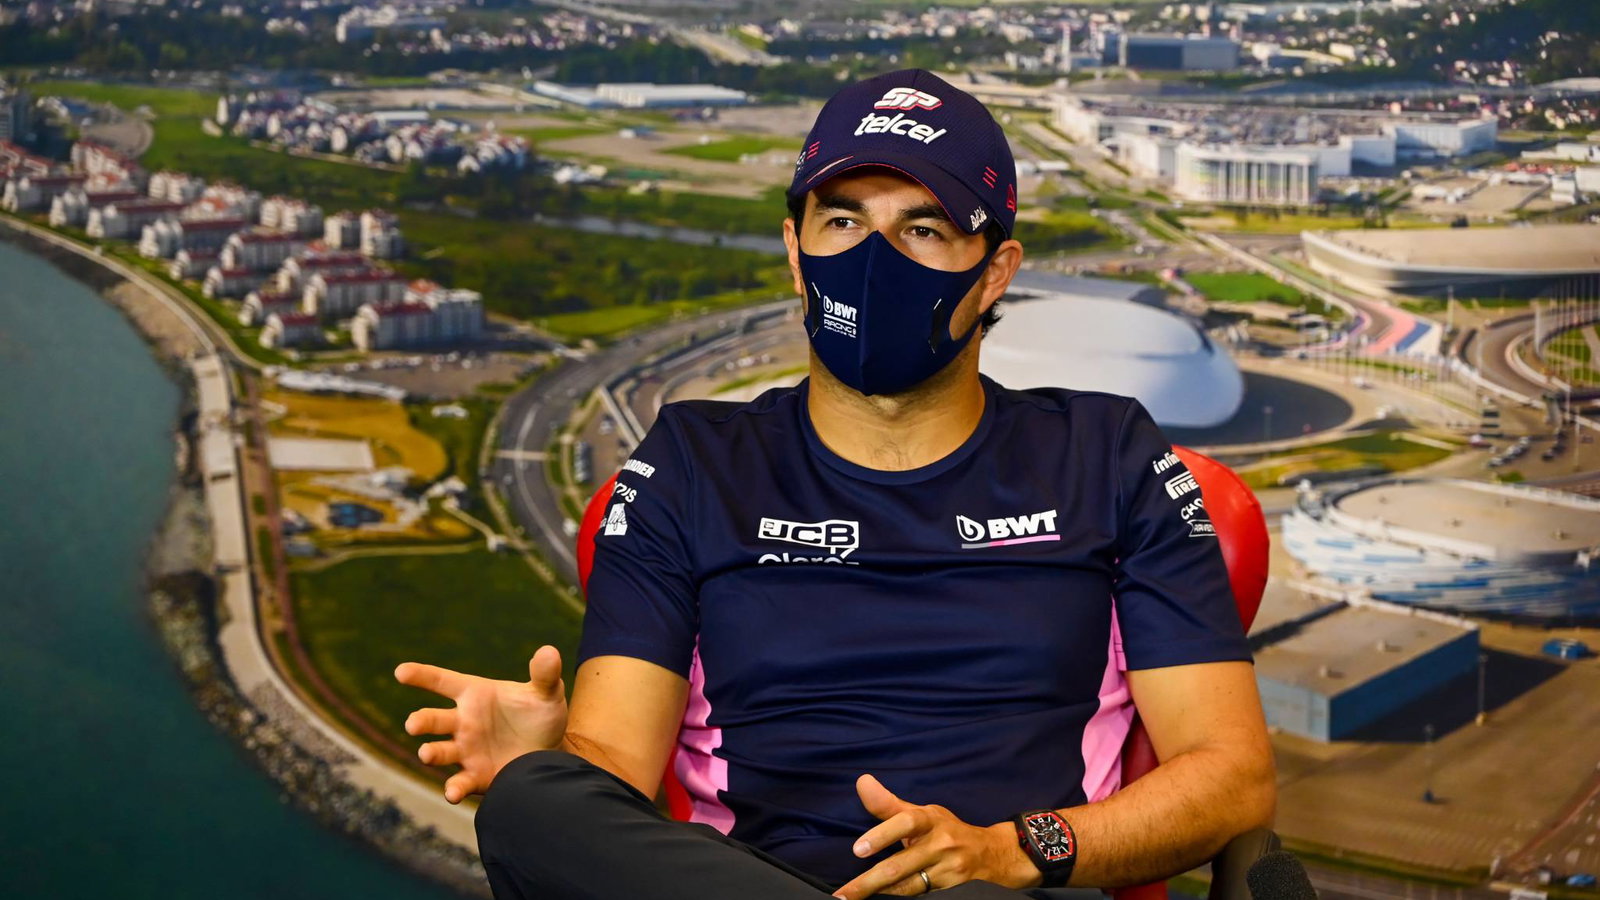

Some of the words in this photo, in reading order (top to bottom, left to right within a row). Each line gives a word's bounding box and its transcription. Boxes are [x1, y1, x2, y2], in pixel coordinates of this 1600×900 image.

[854, 113, 947, 144] telcel
[834, 301, 857, 321] BWT
[762, 522, 857, 547] JCB
[987, 509, 1058, 539] BWT
